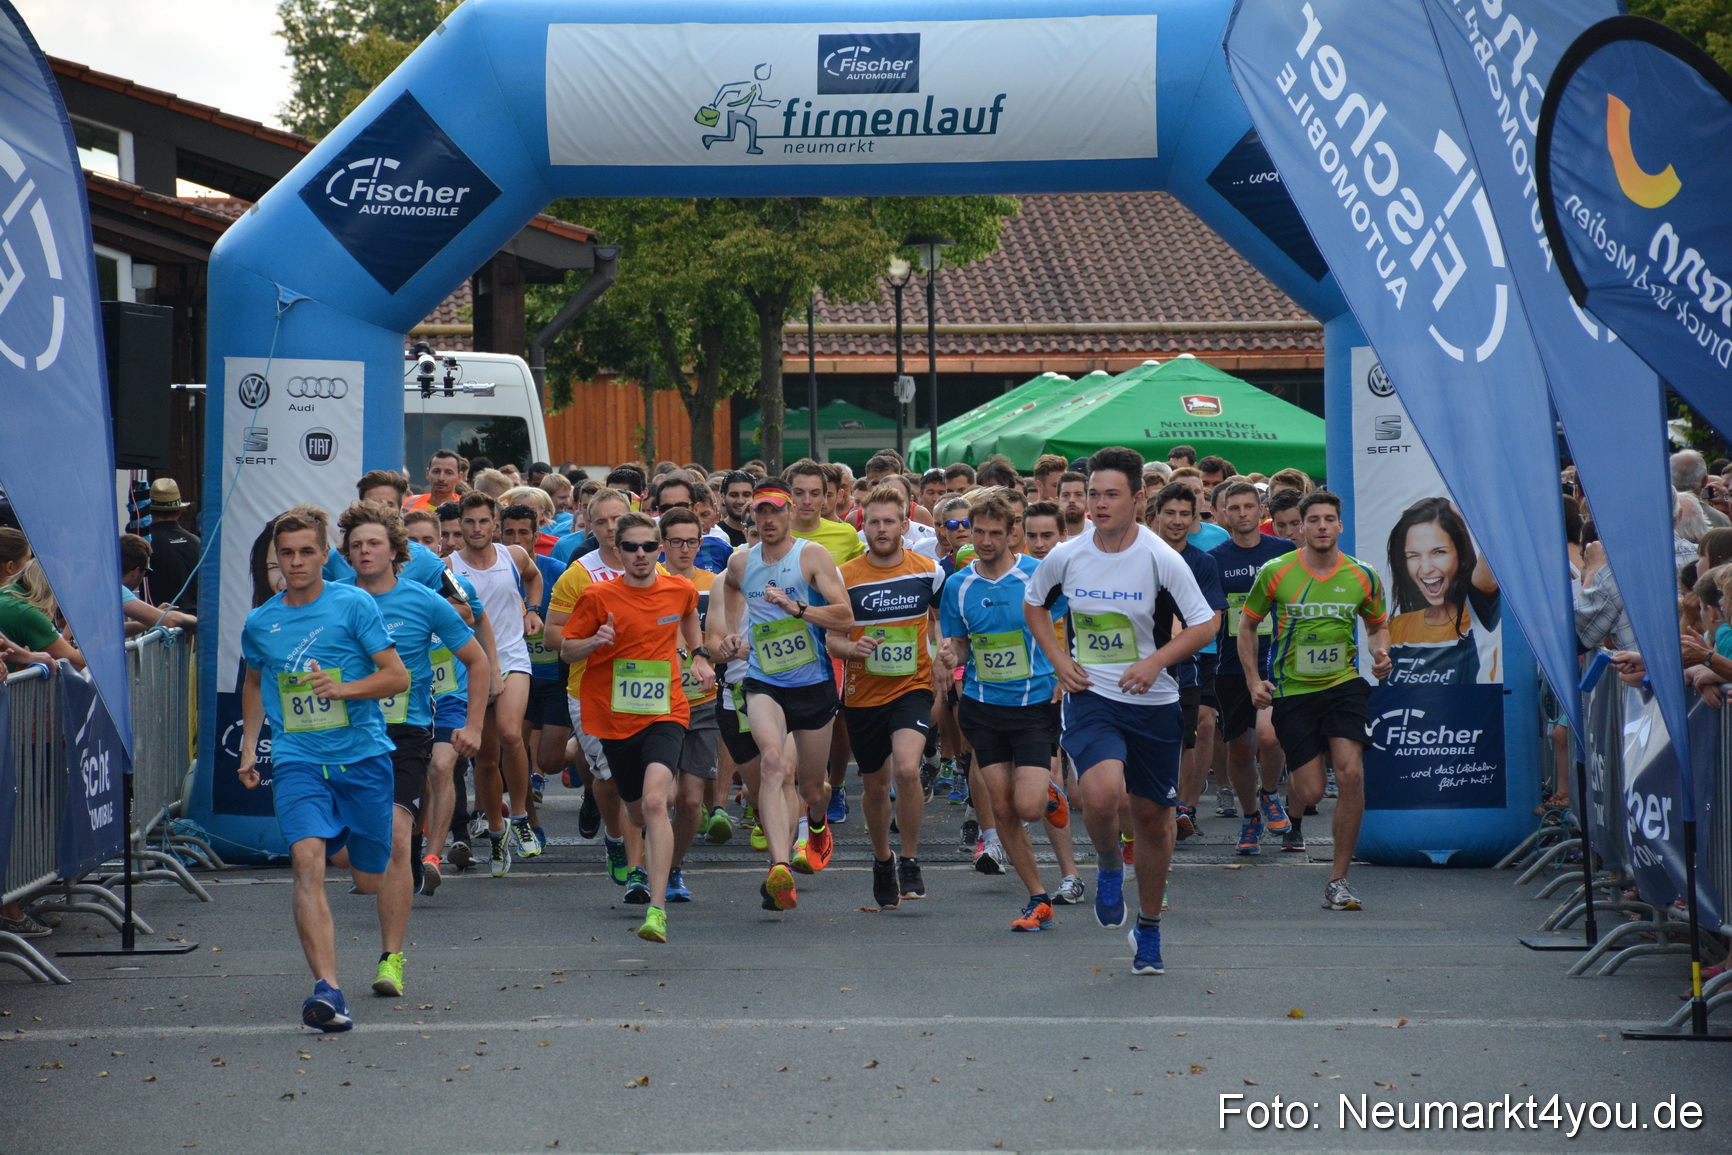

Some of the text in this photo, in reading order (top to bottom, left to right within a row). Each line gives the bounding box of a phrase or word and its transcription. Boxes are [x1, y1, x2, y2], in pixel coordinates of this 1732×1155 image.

[840, 57, 913, 72] Fischer
[846, 72, 907, 80] AUTOMOBILE
[783, 93, 1007, 136] firmenlauf
[783, 139, 875, 154] neumarkt
[349, 178, 470, 203] Fischer
[358, 205, 459, 217] AUTOMOBILE
[288, 403, 315, 412] Audi
[1160, 420, 1257, 430] Neumarkter
[1144, 428, 1278, 441] Lammsbräu
[308, 438, 331, 455] FIAT
[1367, 445, 1412, 454] SEAT
[235, 456, 278, 465] SEAT
[872, 594, 920, 608] Fischer
[1075, 588, 1143, 601] DELPHI
[877, 603, 917, 613] AUTOMOBILE
[1284, 602, 1357, 620] BOCK
[386, 620, 404, 631] Bau
[761, 635, 807, 660] 1336
[1087, 632, 1125, 652] 294
[871, 645, 913, 662] 1638
[983, 651, 1017, 669] 522
[1306, 647, 1340, 664] 145
[618, 680, 665, 699] 1028
[291, 695, 331, 716] 819
[1386, 725, 1483, 745] Fischer
[1394, 746, 1476, 756] AUTOMOBILE
[1411, 767, 1432, 779] und
[1434, 763, 1455, 775] das
[1456, 761, 1498, 774] Lächeln
[1438, 776, 1468, 792] fährt
